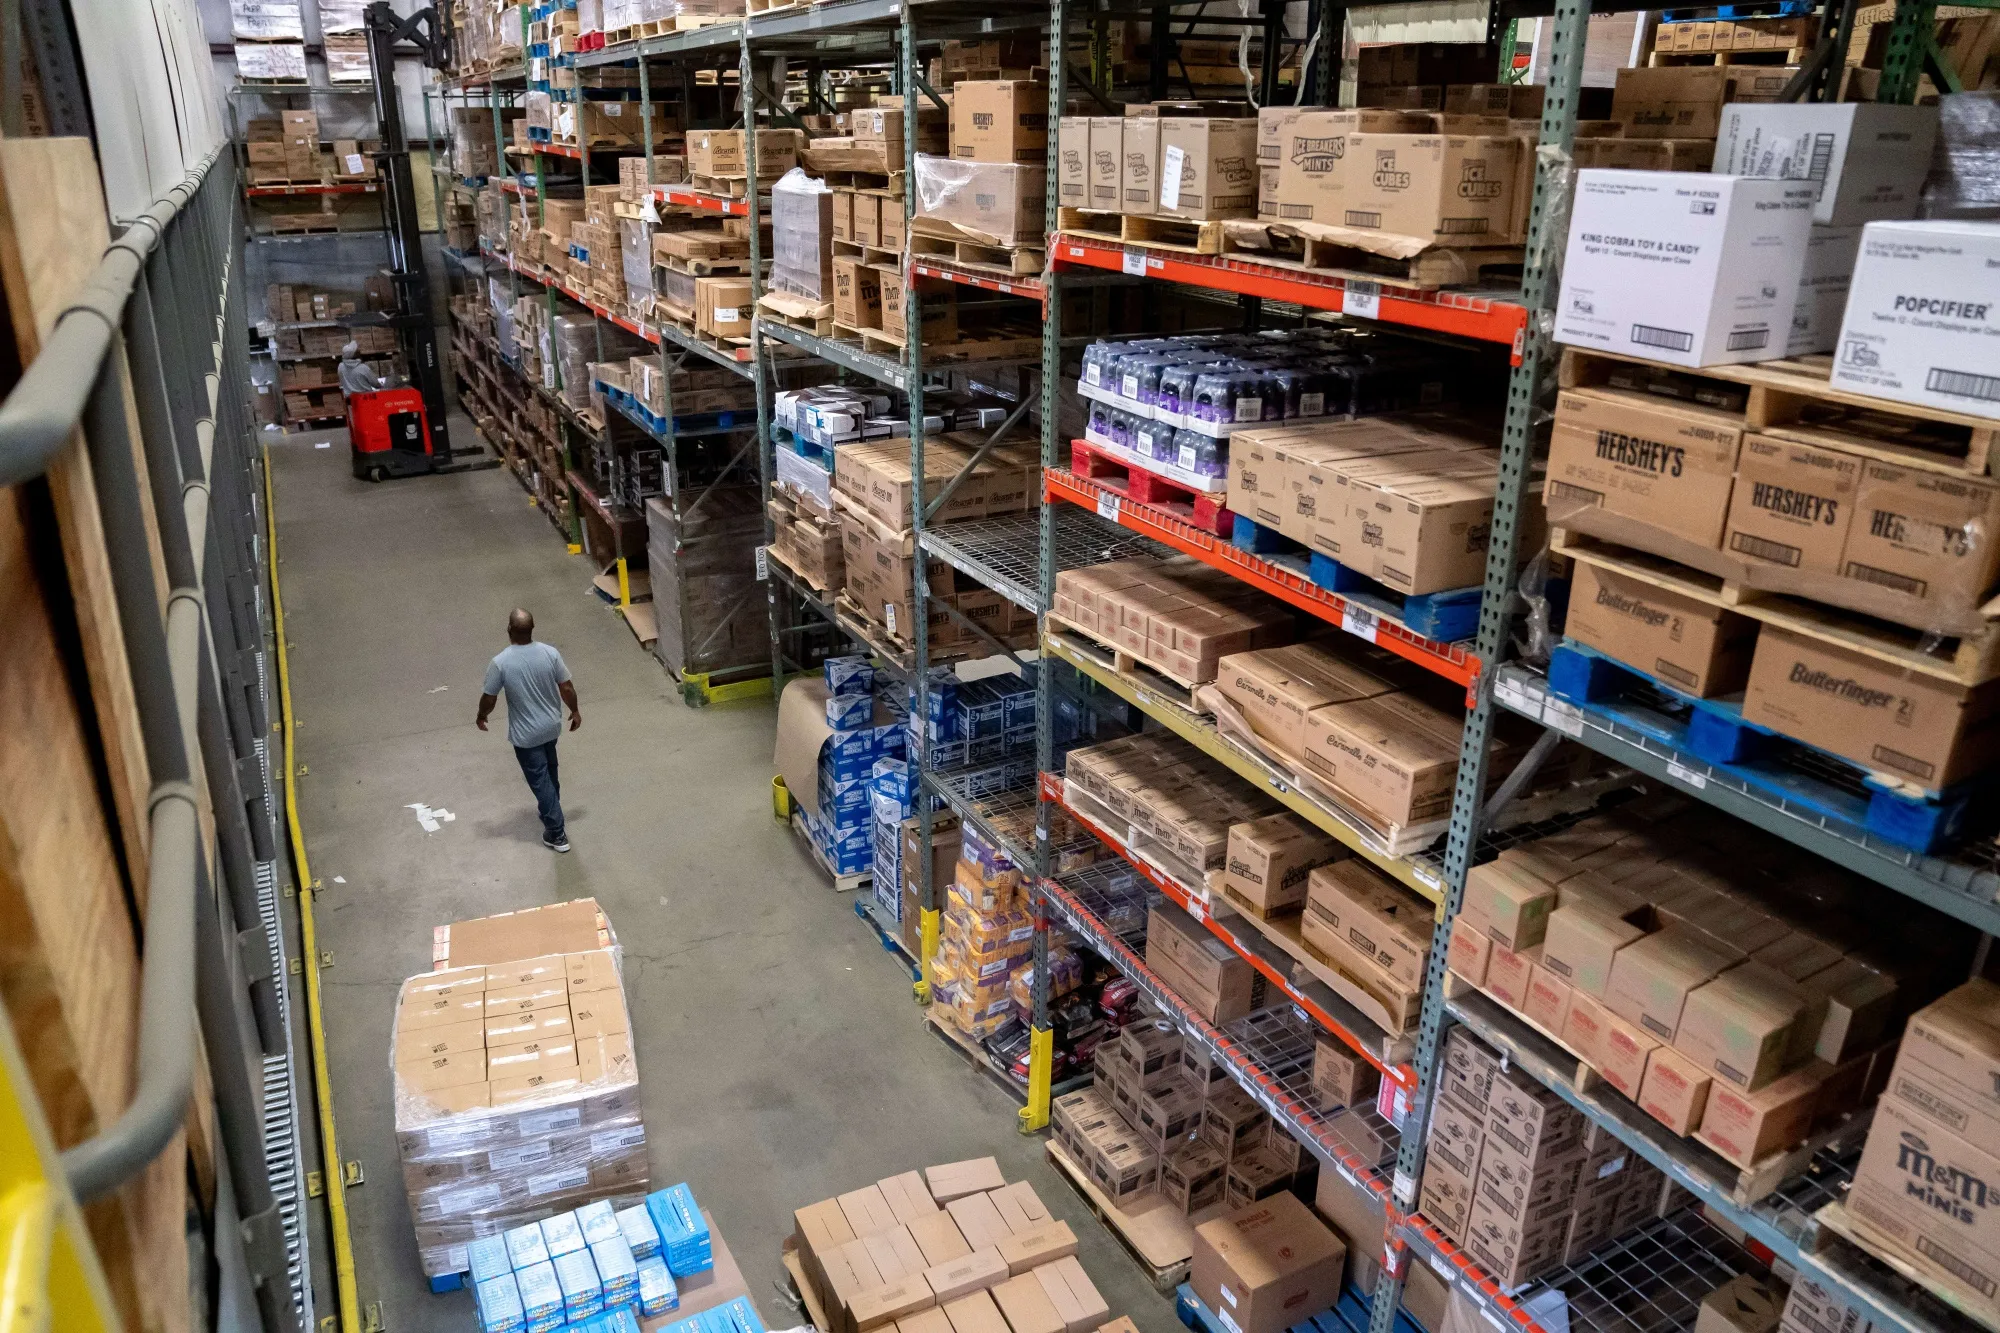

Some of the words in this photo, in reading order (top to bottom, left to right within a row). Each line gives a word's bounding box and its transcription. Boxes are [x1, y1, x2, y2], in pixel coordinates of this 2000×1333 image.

[1306, 137, 1344, 153] BREAKERS
[1303, 157, 1334, 172] MINTS
[1377, 157, 1394, 172] ICE
[1463, 167, 1485, 181] ICE
[1373, 172, 1410, 188] CUBES
[1458, 182, 1501, 197] CUBES
[1581, 233, 1602, 244] KING
[1604, 236, 1635, 248] COBRA
[1637, 240, 1655, 250] TOY
[1666, 243, 1700, 255] CANDY
[1894, 295, 1987, 321] POPCIFIER
[425, 342, 434, 367] TOYOTA
[1596, 429, 1685, 477] HERSHEY'S
[1752, 481, 1838, 525] HERSHEY'S
[1596, 586, 1670, 626] Butterfinger
[1789, 662, 1893, 707] Butterfinger
[1898, 698, 1909, 715] 2
